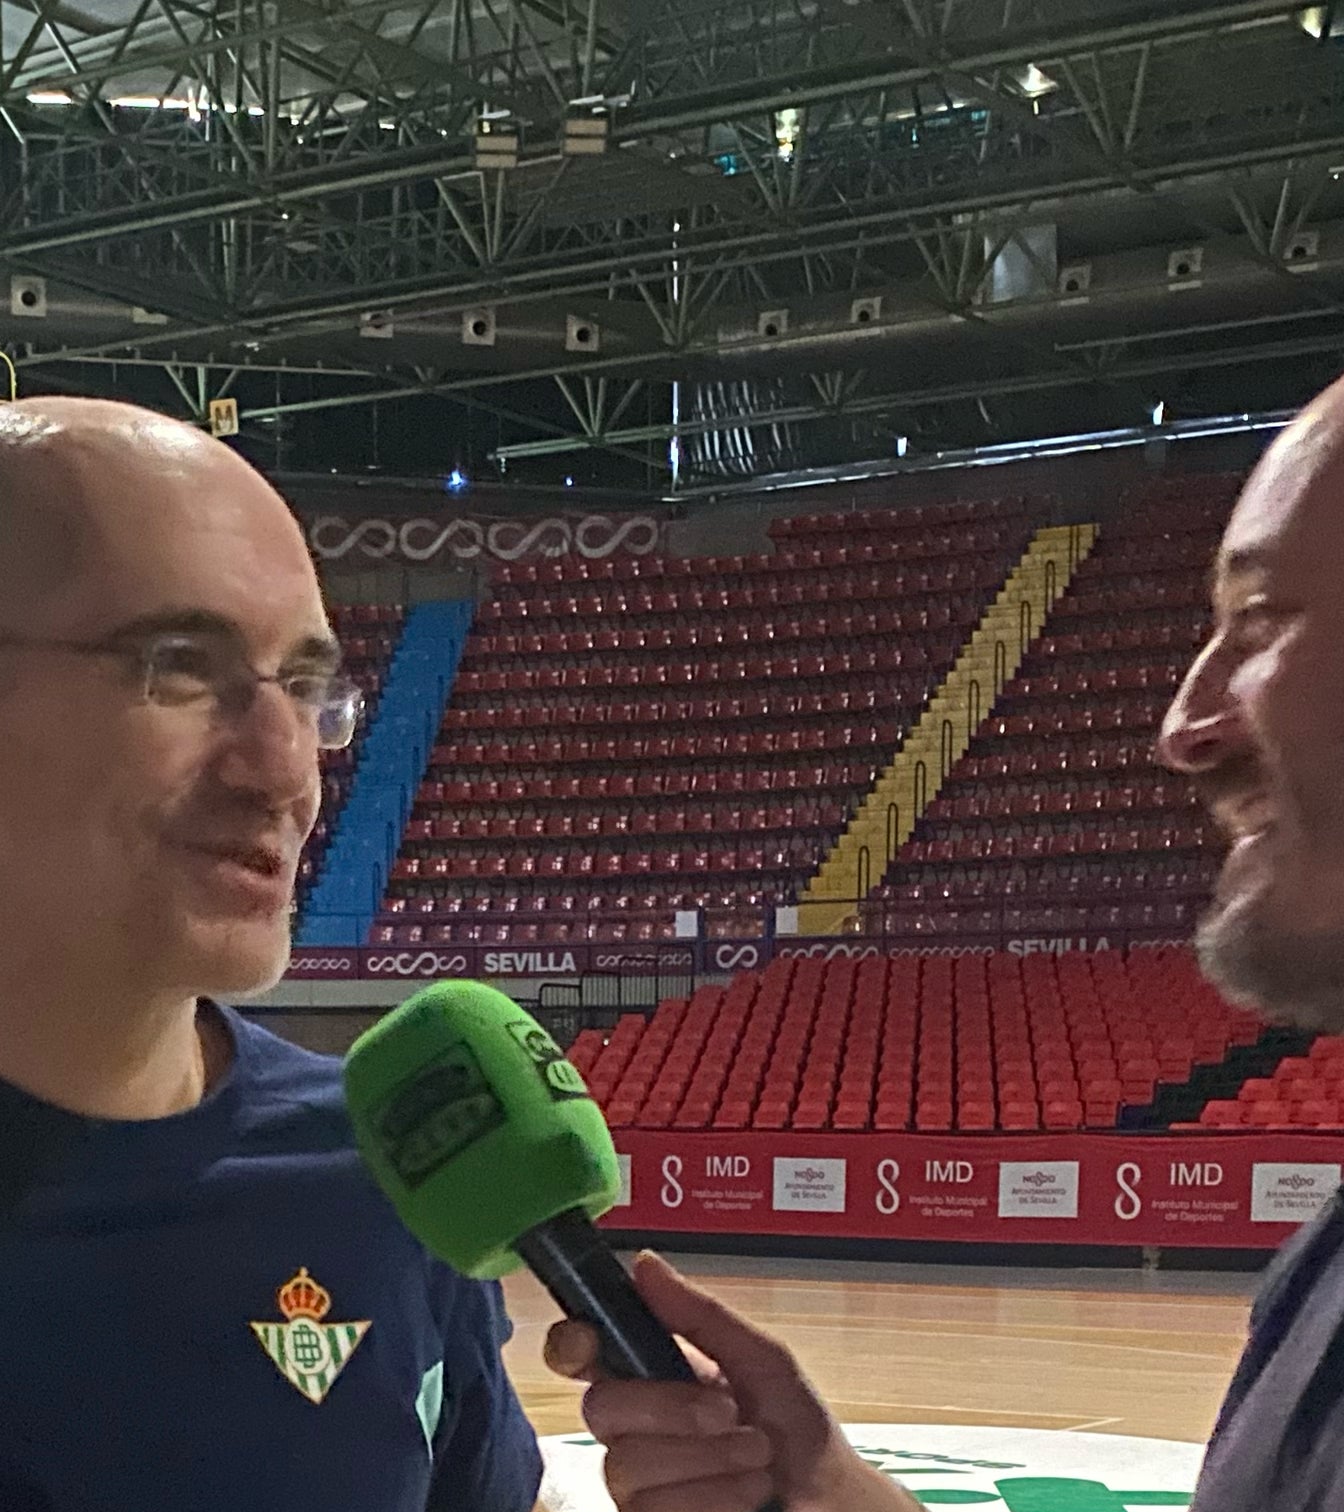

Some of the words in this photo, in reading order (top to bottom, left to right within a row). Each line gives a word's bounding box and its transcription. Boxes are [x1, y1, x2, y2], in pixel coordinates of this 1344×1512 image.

[483, 951, 576, 972] SEVILLA
[706, 1155, 750, 1177] IMD
[925, 1160, 974, 1183] IMD
[1169, 1162, 1224, 1186] IMD
